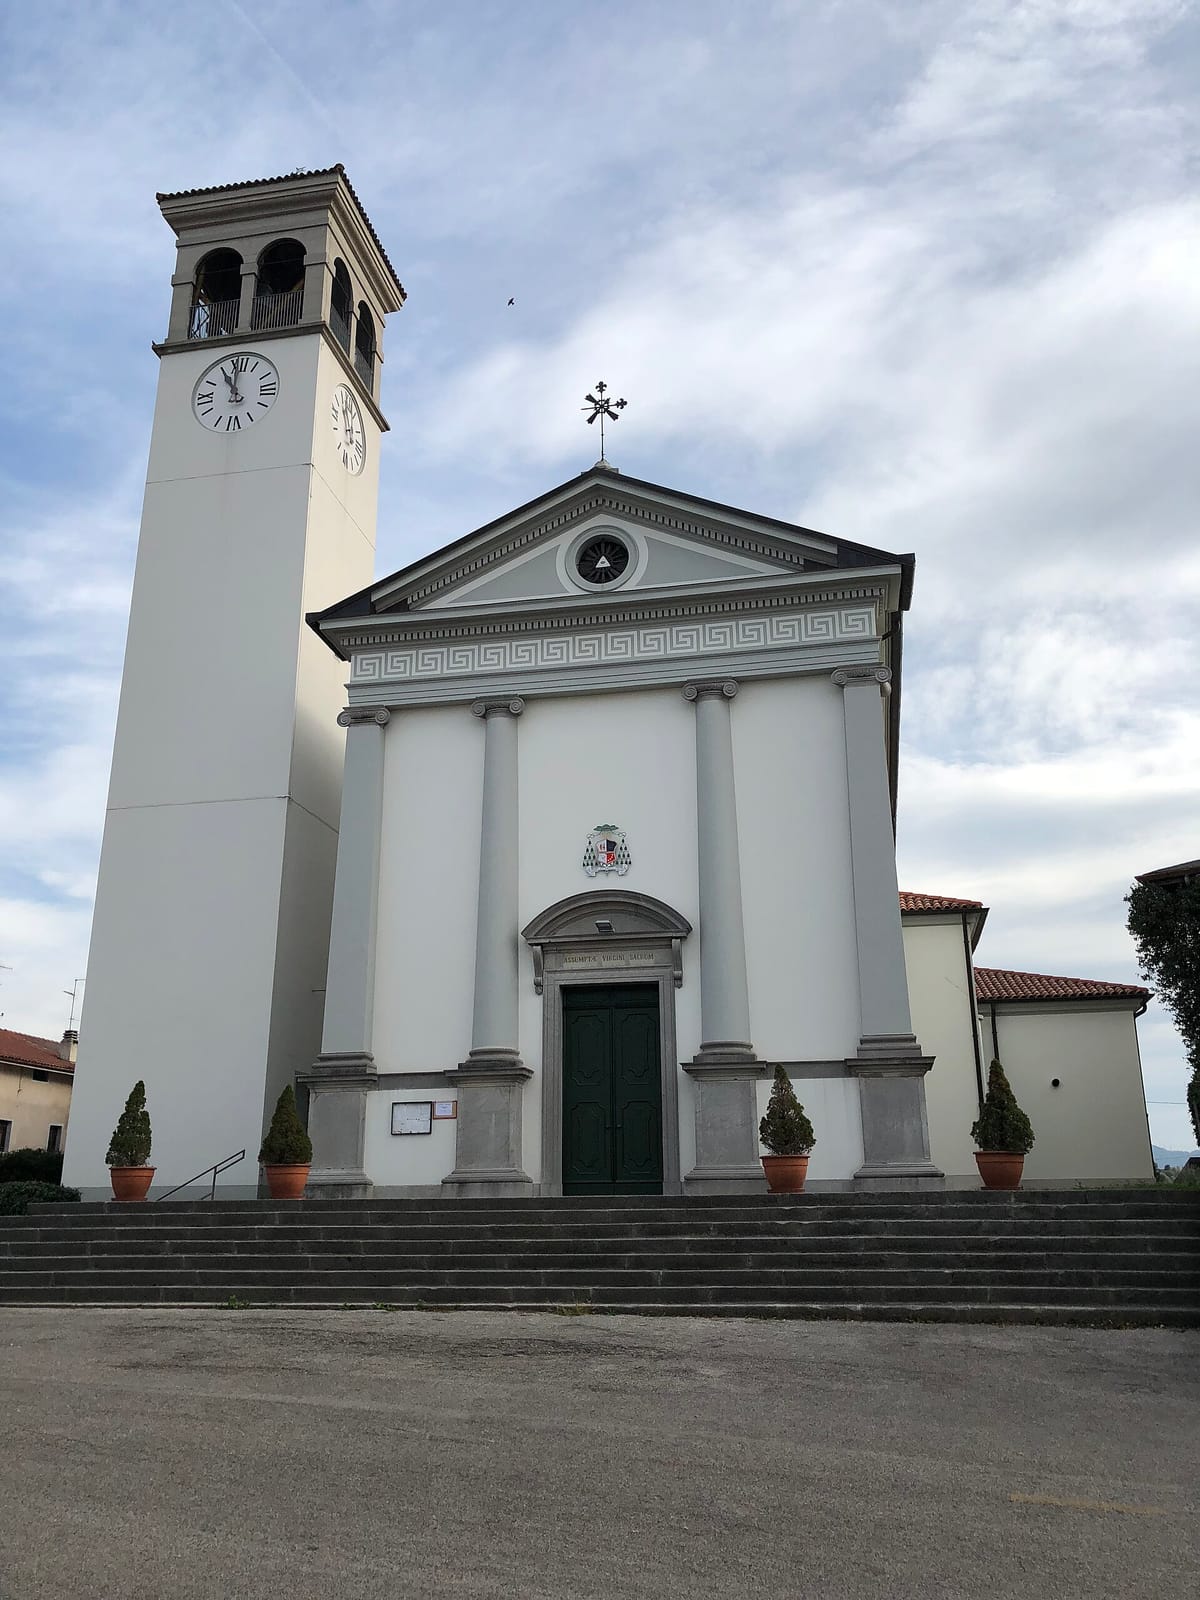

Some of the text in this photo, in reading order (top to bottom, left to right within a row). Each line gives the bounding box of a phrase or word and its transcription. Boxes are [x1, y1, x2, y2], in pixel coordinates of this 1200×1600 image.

[260, 381, 277, 396] III
[197, 391, 214, 406] IX
[226, 415, 242, 431] VI
